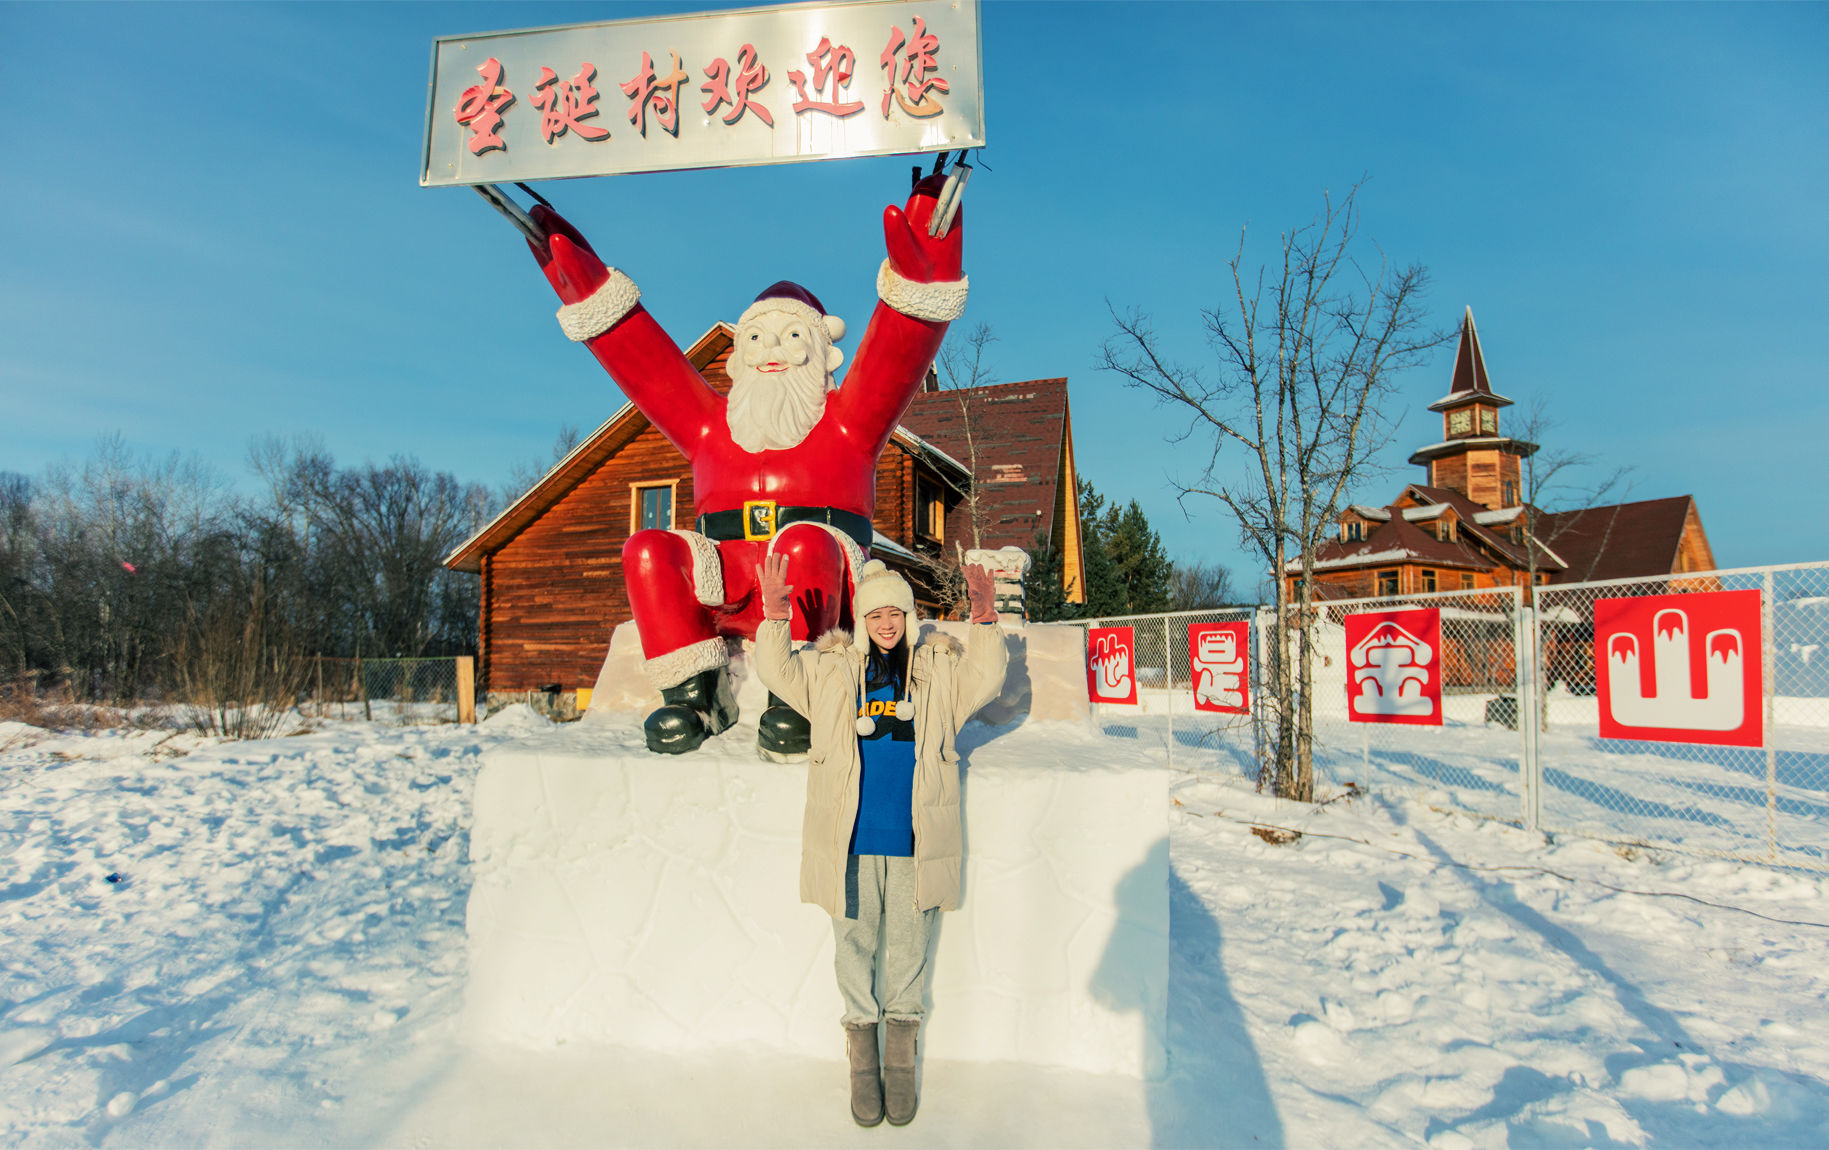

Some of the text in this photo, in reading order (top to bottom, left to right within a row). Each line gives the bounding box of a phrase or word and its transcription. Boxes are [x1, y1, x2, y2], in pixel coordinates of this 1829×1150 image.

[455, 15, 950, 157] 圣诞村欢迎您
[1193, 630, 1244, 707] 是
[1350, 621, 1433, 716] 金
[1608, 608, 1745, 731] 山
